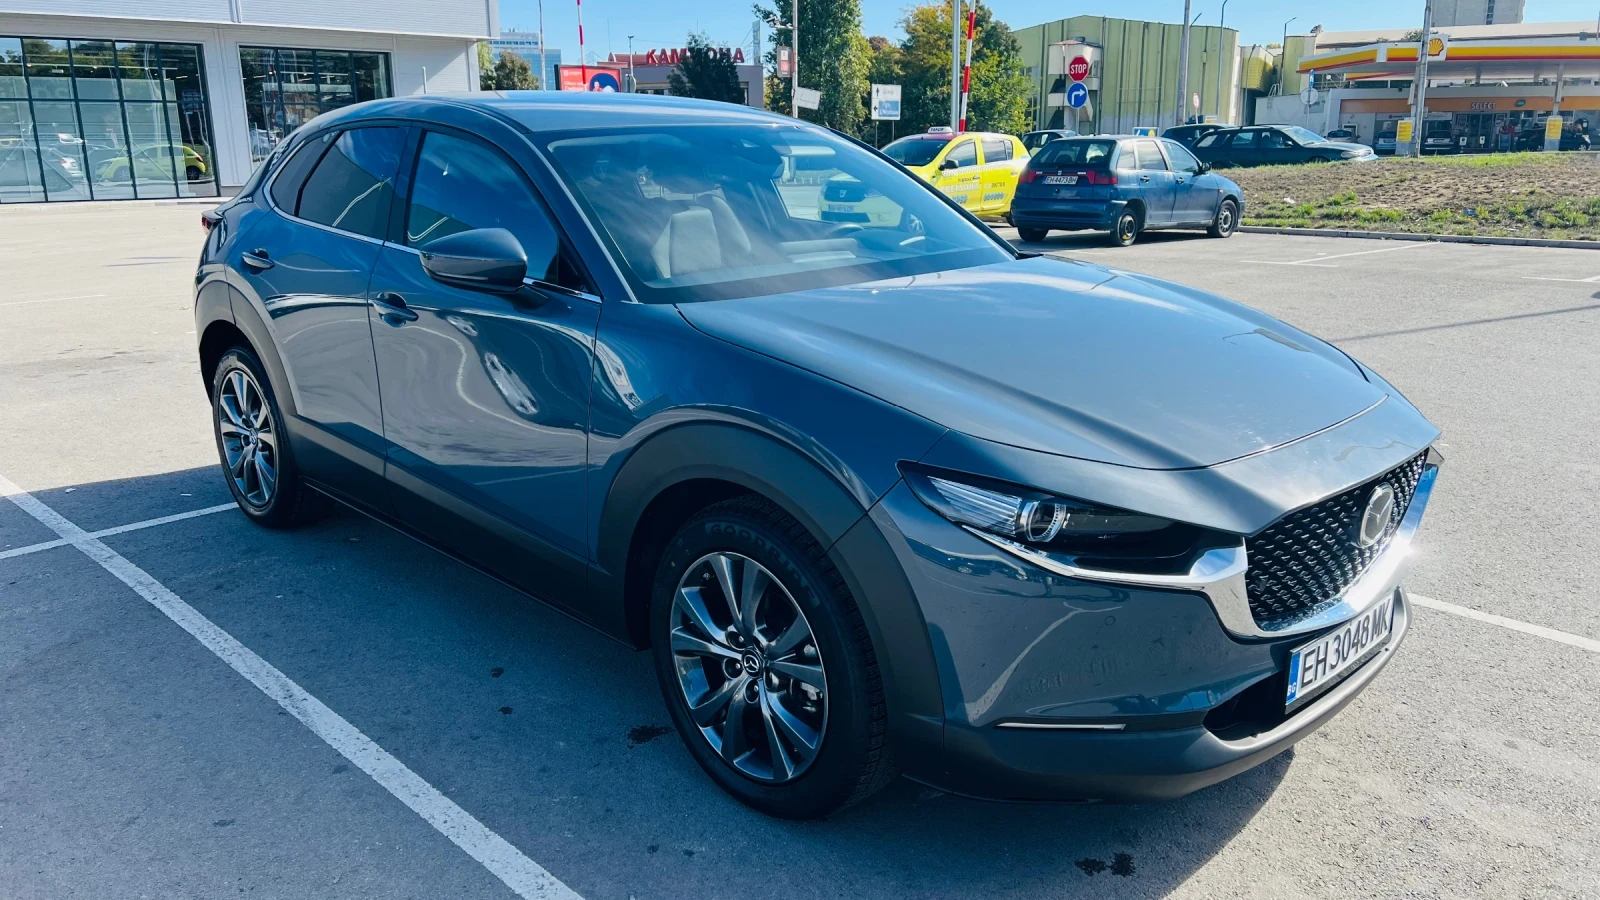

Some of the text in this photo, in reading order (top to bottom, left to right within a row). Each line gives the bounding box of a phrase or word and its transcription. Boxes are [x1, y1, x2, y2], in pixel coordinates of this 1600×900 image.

[1070, 63, 1087, 74] STOP
[1471, 102, 1496, 110] SELECT
[1287, 682, 1297, 696] BG
